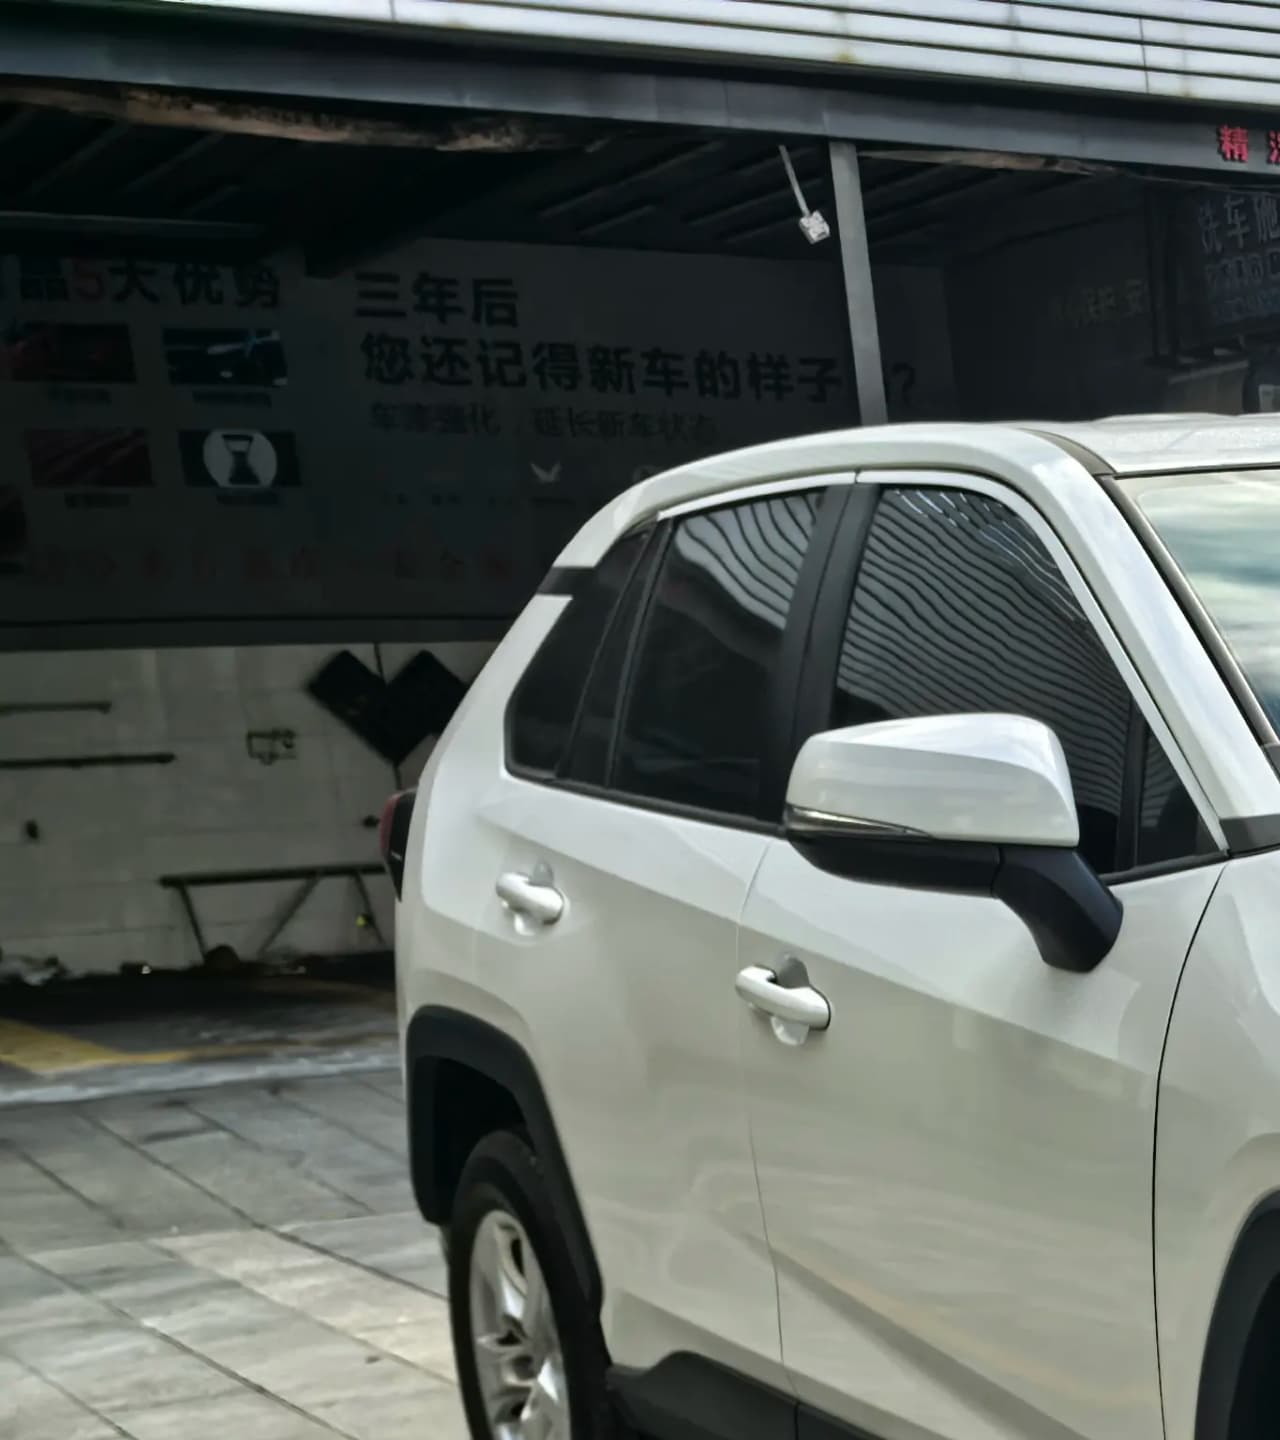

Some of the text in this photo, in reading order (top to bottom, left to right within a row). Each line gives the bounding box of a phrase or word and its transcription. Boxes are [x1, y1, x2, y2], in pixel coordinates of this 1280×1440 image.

[354, 271, 520, 329] 三年后
[360, 332, 916, 406] 您还记得新车的样子?
